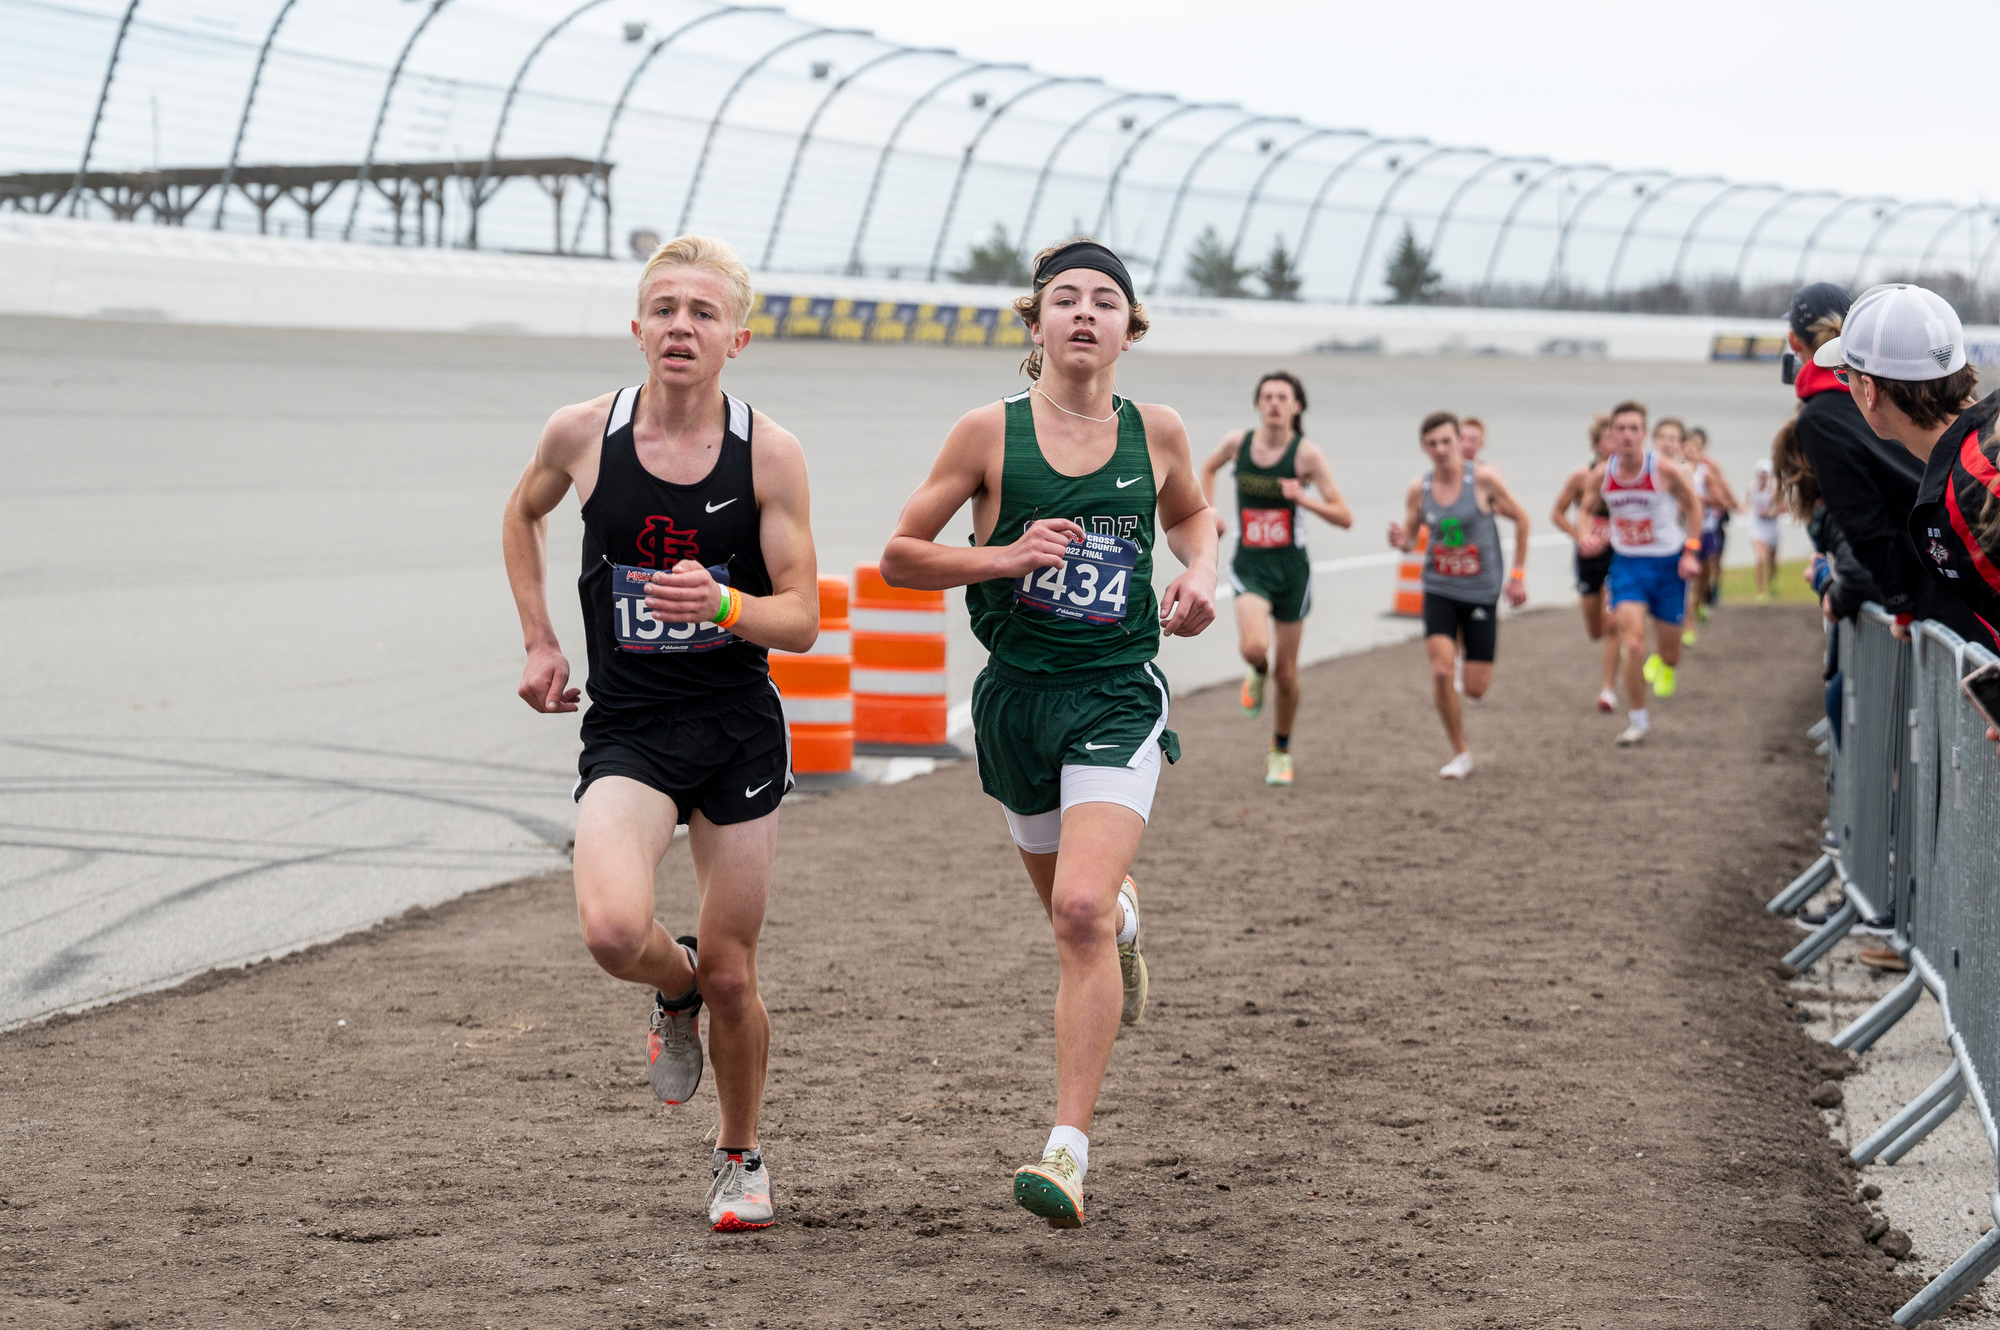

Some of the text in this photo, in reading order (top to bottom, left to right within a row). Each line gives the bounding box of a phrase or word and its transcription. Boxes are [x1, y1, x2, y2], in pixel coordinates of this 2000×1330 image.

[1086, 534, 1115, 545] CROSS
[1065, 546, 1104, 560] 022 FINAL
[1085, 541, 1123, 554] COUNTRY
